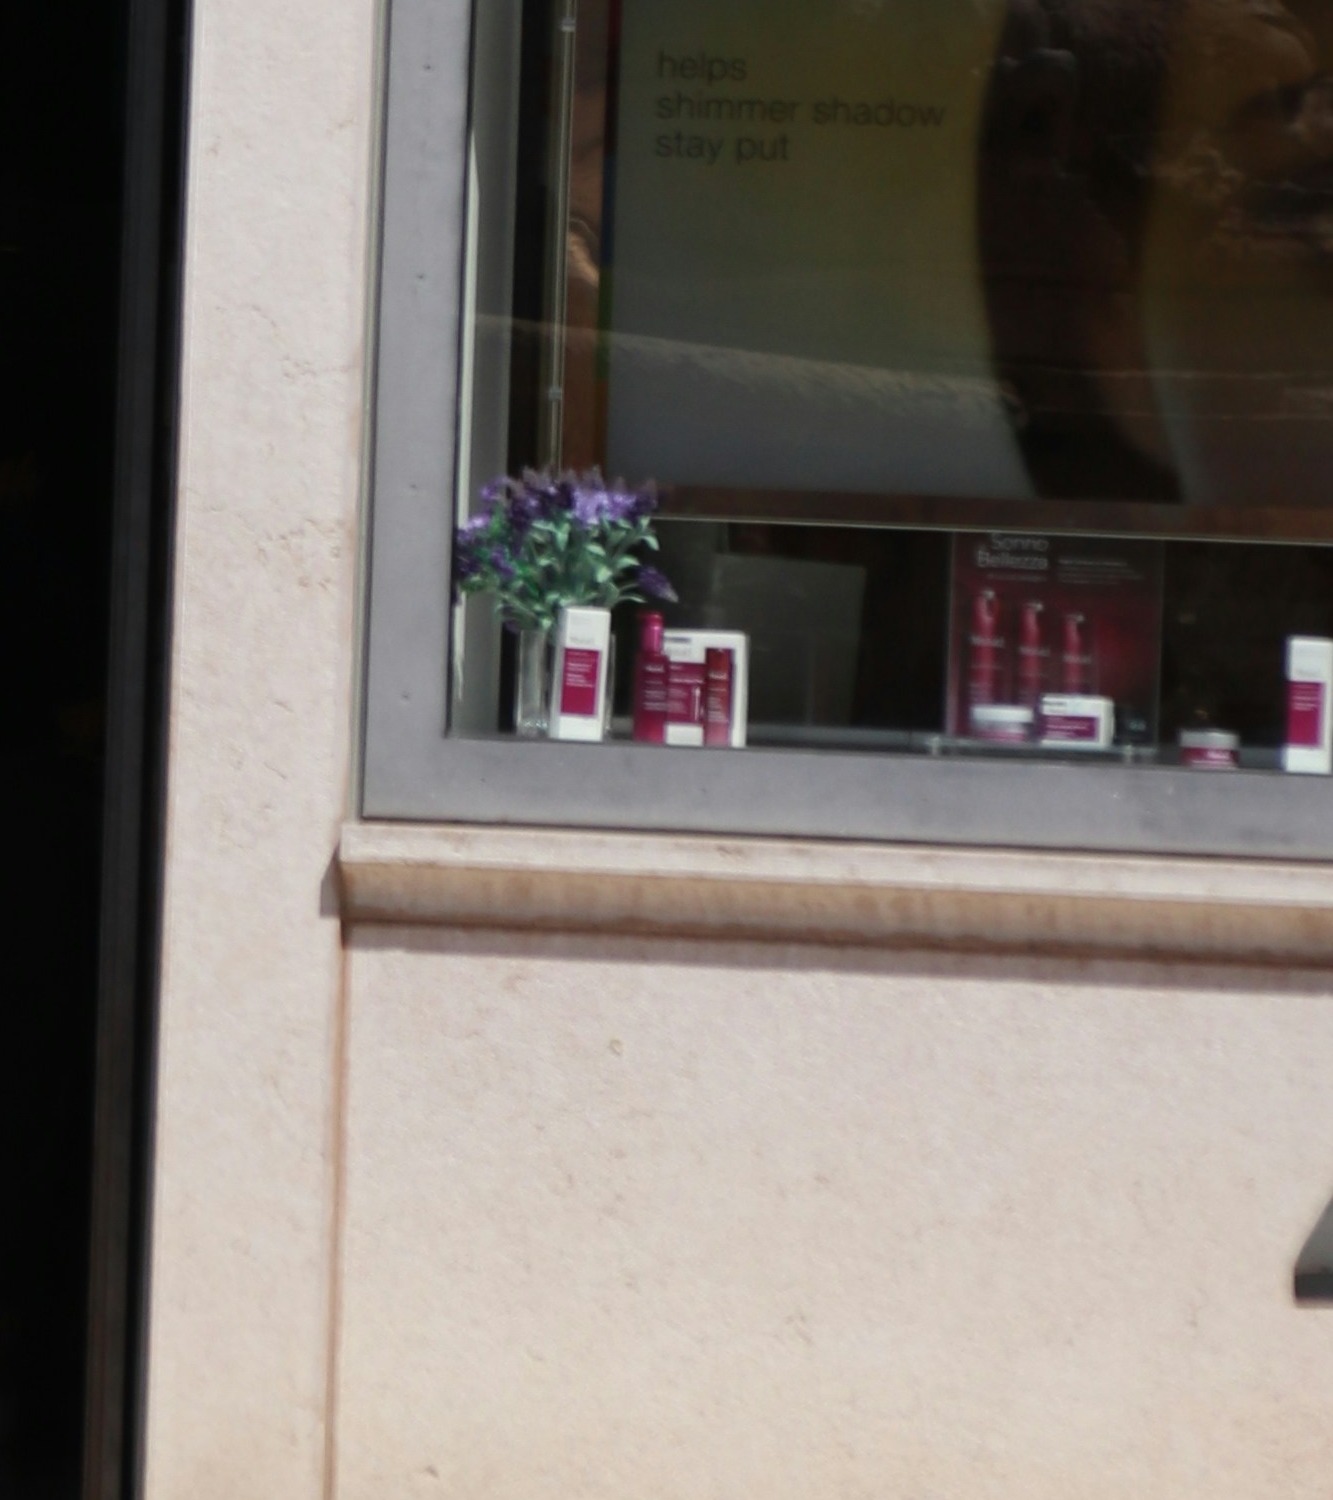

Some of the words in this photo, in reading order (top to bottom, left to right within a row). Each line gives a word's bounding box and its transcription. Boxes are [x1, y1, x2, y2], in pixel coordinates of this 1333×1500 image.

[657, 49, 747, 86] helps
[656, 91, 801, 123] shimmer
[812, 95, 947, 128] shadow
[655, 131, 724, 165] stay
[736, 133, 790, 165] put
